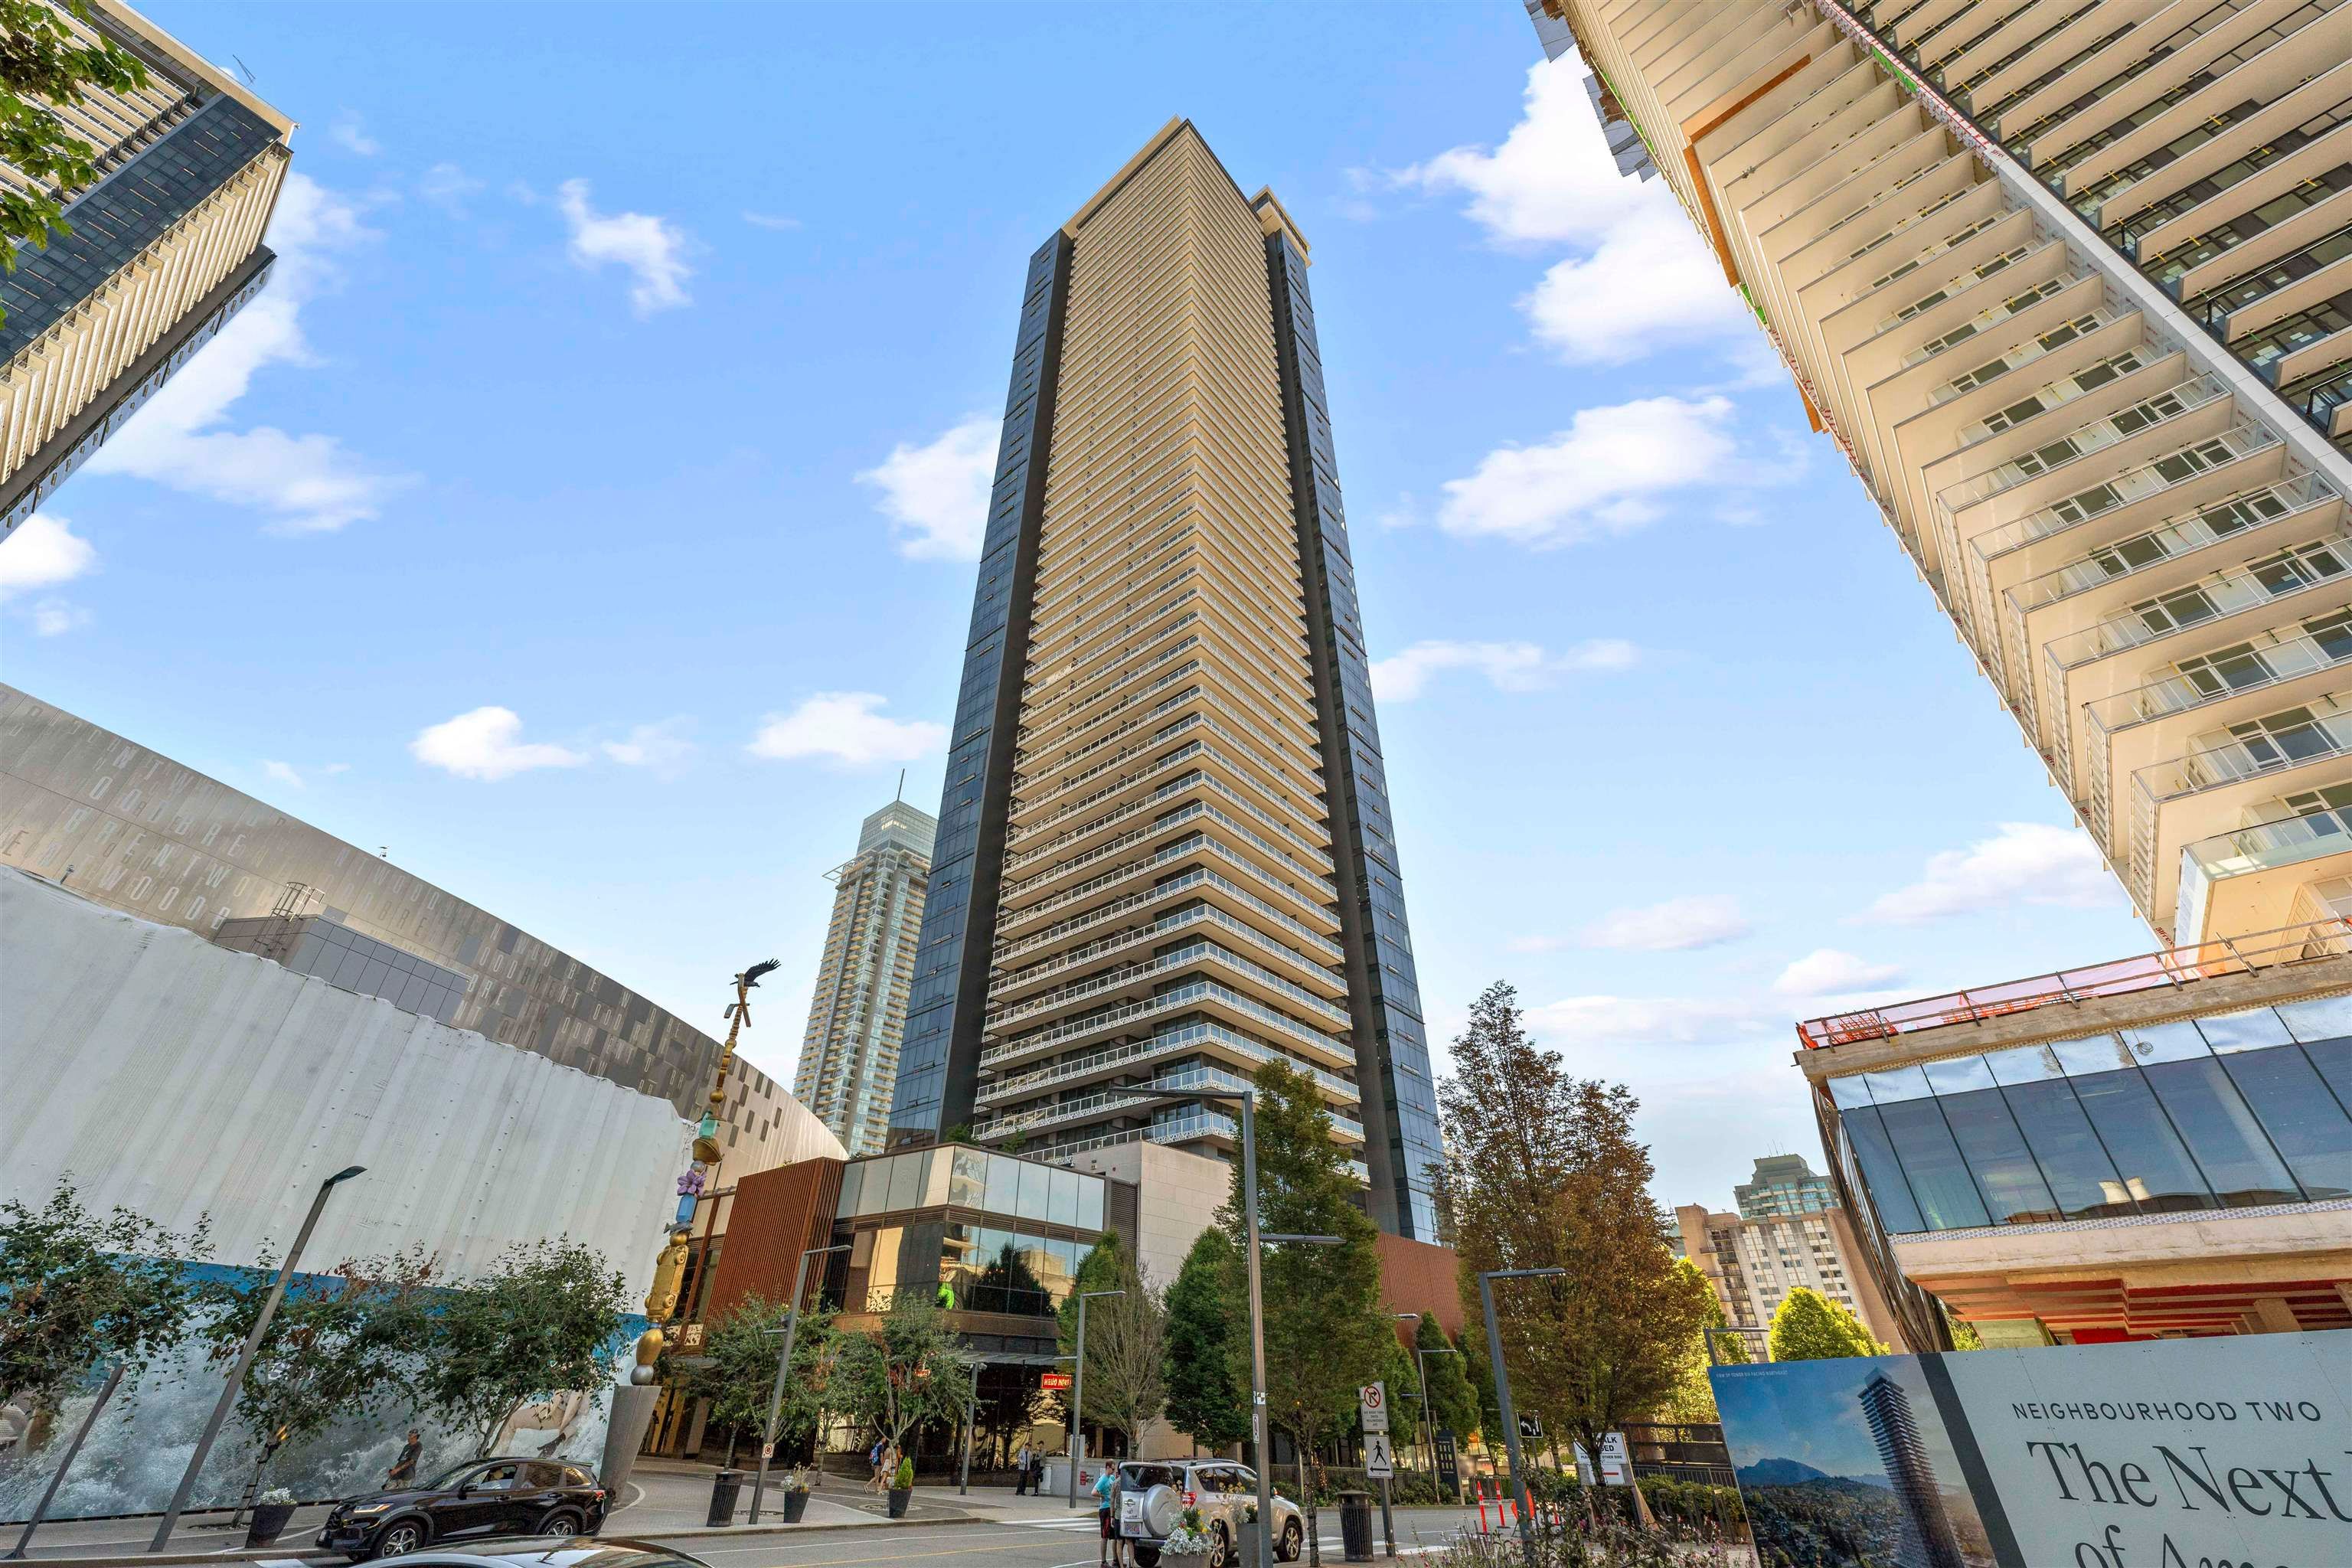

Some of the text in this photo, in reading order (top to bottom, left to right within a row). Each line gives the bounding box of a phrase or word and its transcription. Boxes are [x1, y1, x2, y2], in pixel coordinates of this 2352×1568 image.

[2011, 1401, 2321, 1422] NEIGHBOURHOOD TWO
[2026, 1441, 2352, 1523] The Next
